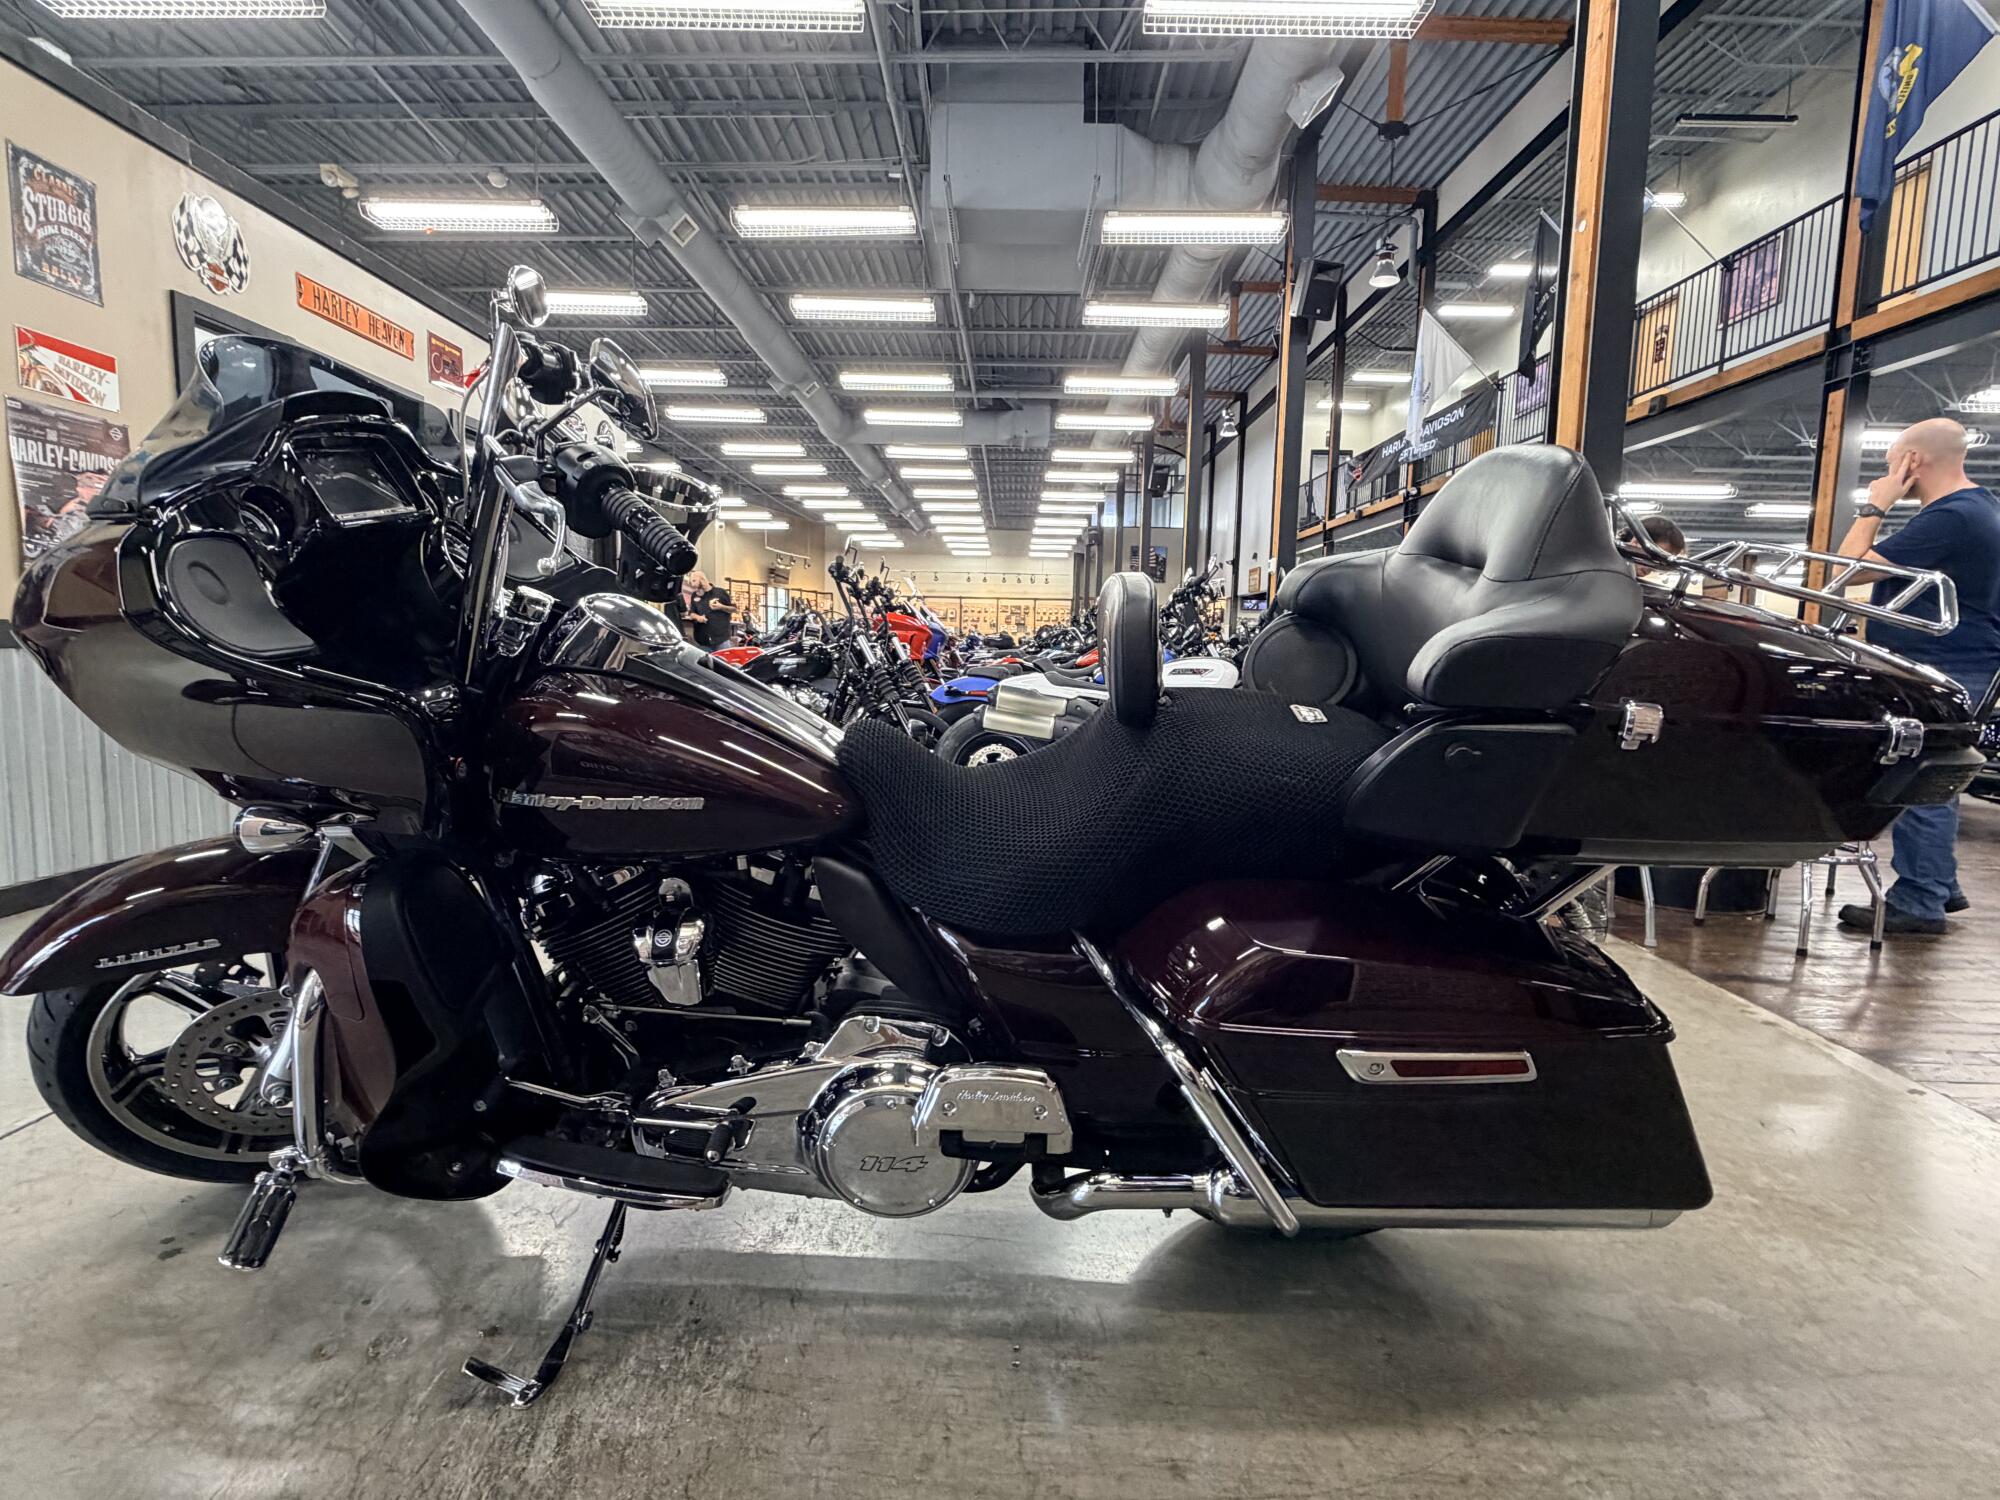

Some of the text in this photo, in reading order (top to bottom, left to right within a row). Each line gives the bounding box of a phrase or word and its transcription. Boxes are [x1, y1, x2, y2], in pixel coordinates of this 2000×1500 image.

[22, 185, 92, 234] STURGIS
[312, 285, 360, 330] HARLEY
[367, 313, 406, 353] HEAVEN
[54, 363, 107, 407] DAVIDSON
[58, 355, 111, 386] HARLEY-
[9, 435, 121, 474] HARLEY-DAVIDS
[94, 938, 221, 968] LIMITED
[860, 1155, 929, 1173] 114
